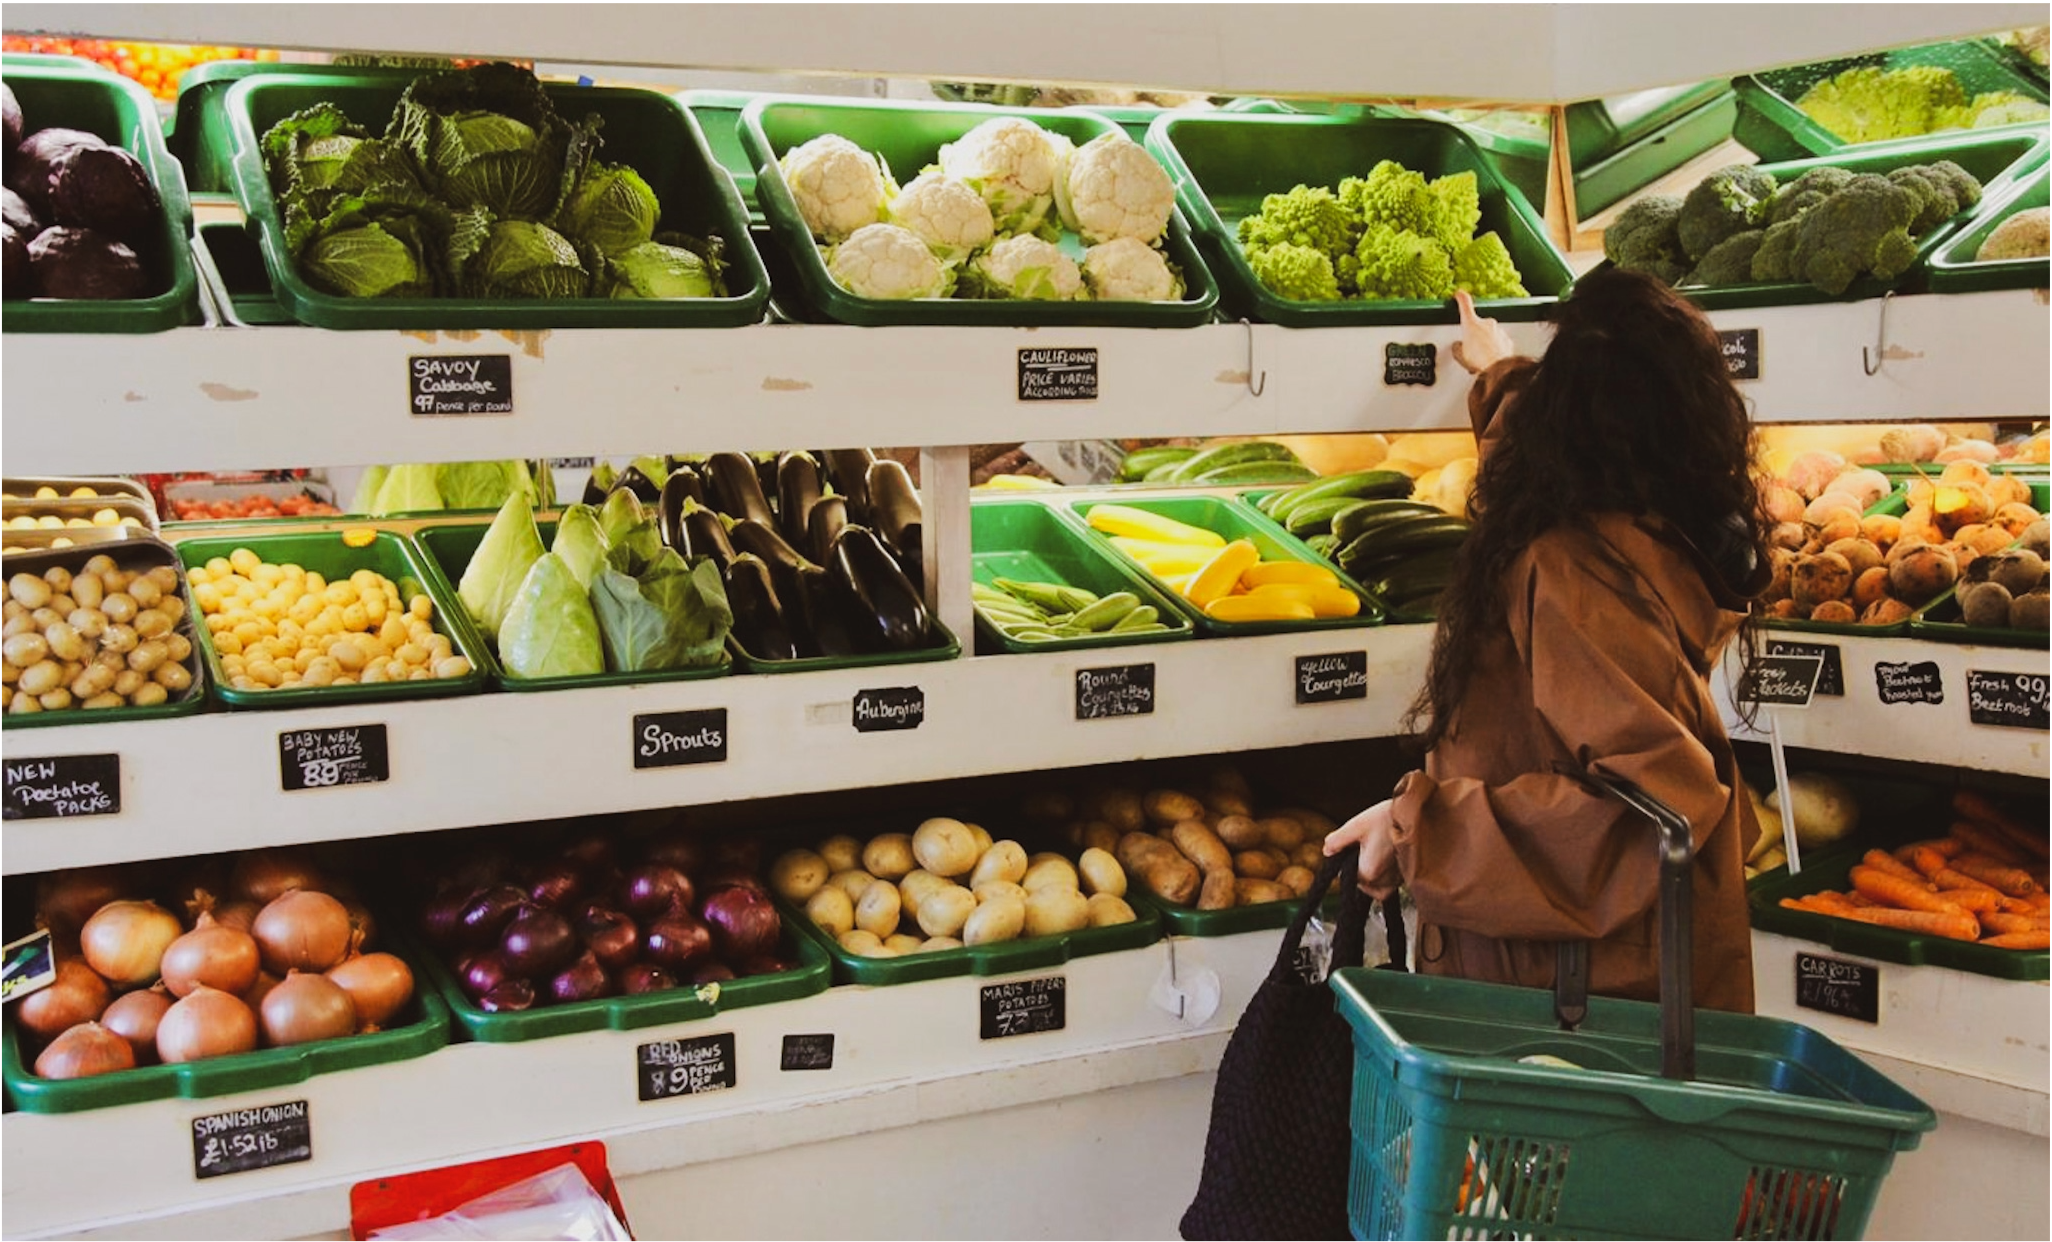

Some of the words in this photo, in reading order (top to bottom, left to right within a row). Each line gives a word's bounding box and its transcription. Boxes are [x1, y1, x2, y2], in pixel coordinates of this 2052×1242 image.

[1722, 336, 1747, 356] coli
[1022, 371, 1054, 388] PRICE
[414, 395, 434, 412] 97
[856, 697, 923, 724] Aubergine
[283, 731, 322, 751] BABY
[327, 729, 360, 744] NEW
[7, 761, 56, 786] NEW
[303, 761, 339, 786] 89
[53, 795, 112, 817] PACKS
[1801, 957, 1861, 980] CARROTS
[983, 984, 1023, 1001] MARIS
[649, 1040, 680, 1060] RED
[668, 1044, 722, 1064] ONIONS
[689, 1061, 725, 1078] PENCE
[194, 1108, 260, 1138] SPANISH
[261, 1103, 304, 1123] ONION
